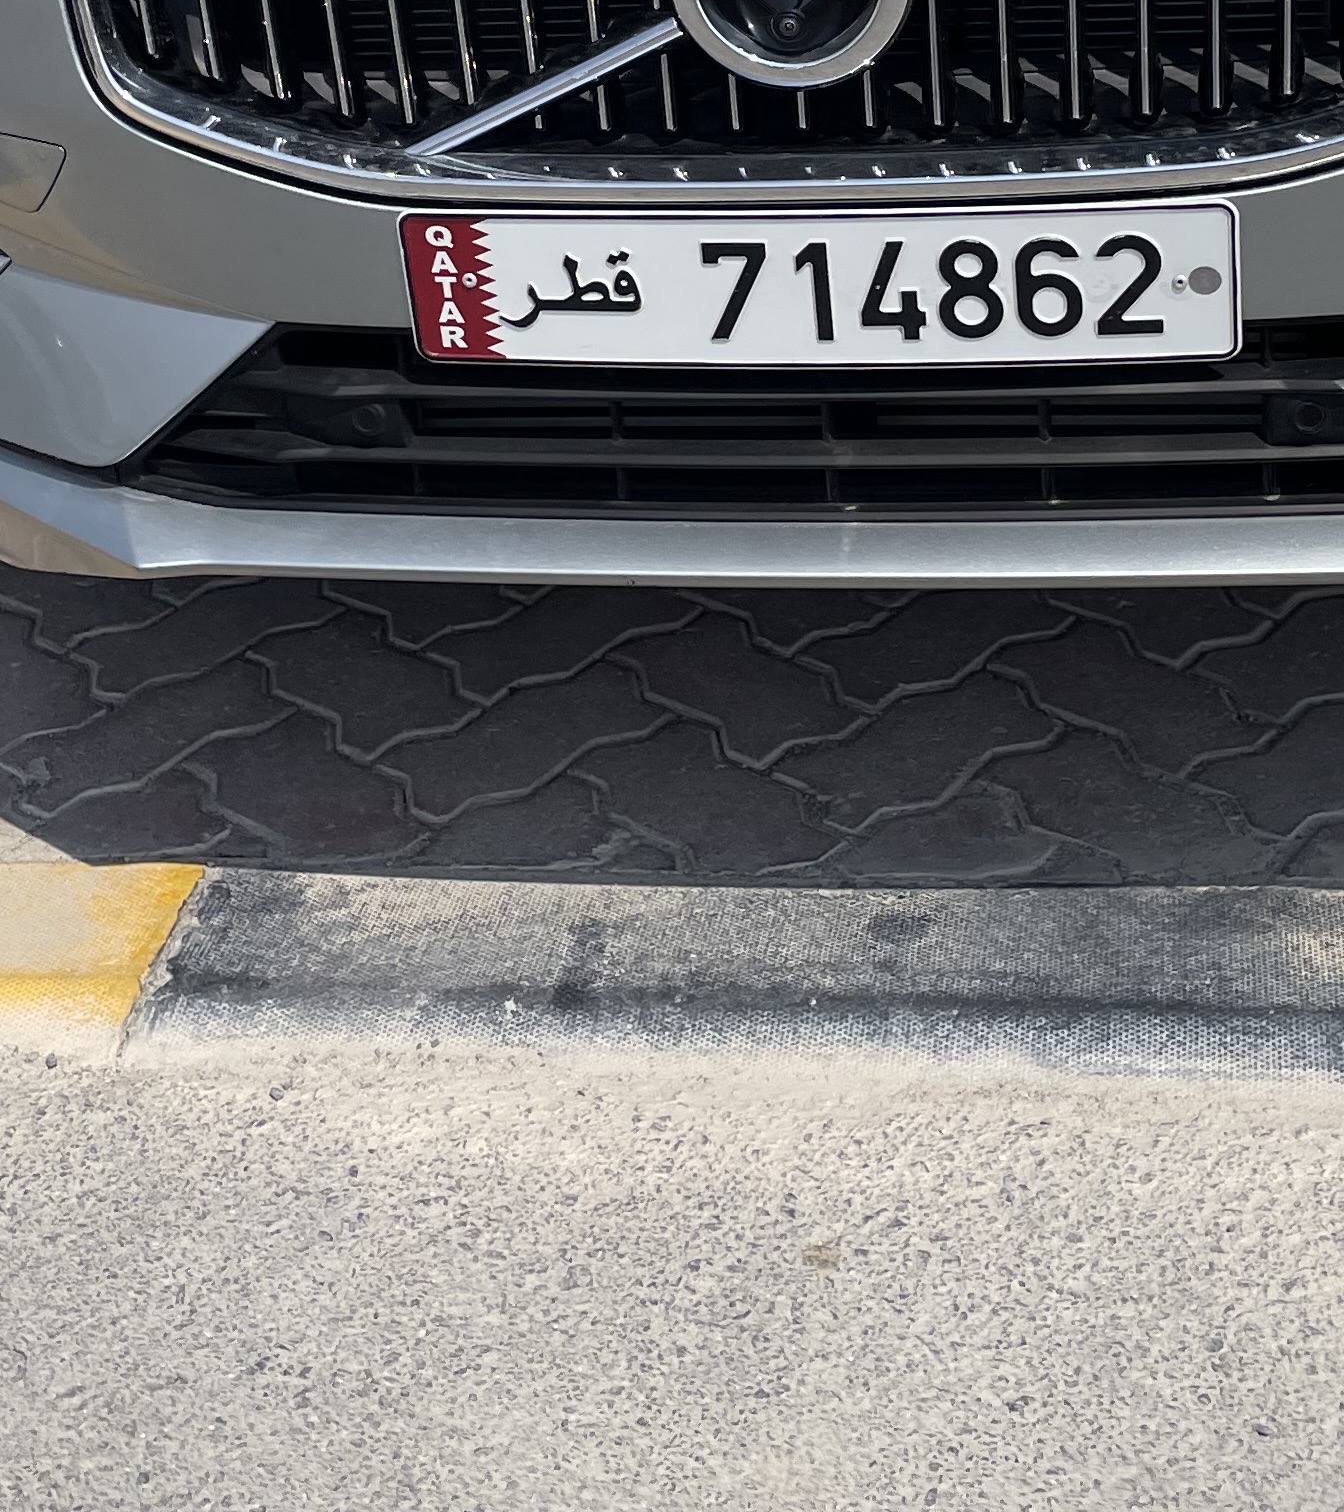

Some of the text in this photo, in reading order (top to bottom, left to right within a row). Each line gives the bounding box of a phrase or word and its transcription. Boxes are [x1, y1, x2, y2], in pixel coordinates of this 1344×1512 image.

[424, 225, 469, 349] QATAR
[499, 248, 644, 329] قطر
[699, 234, 1165, 343] 714862
